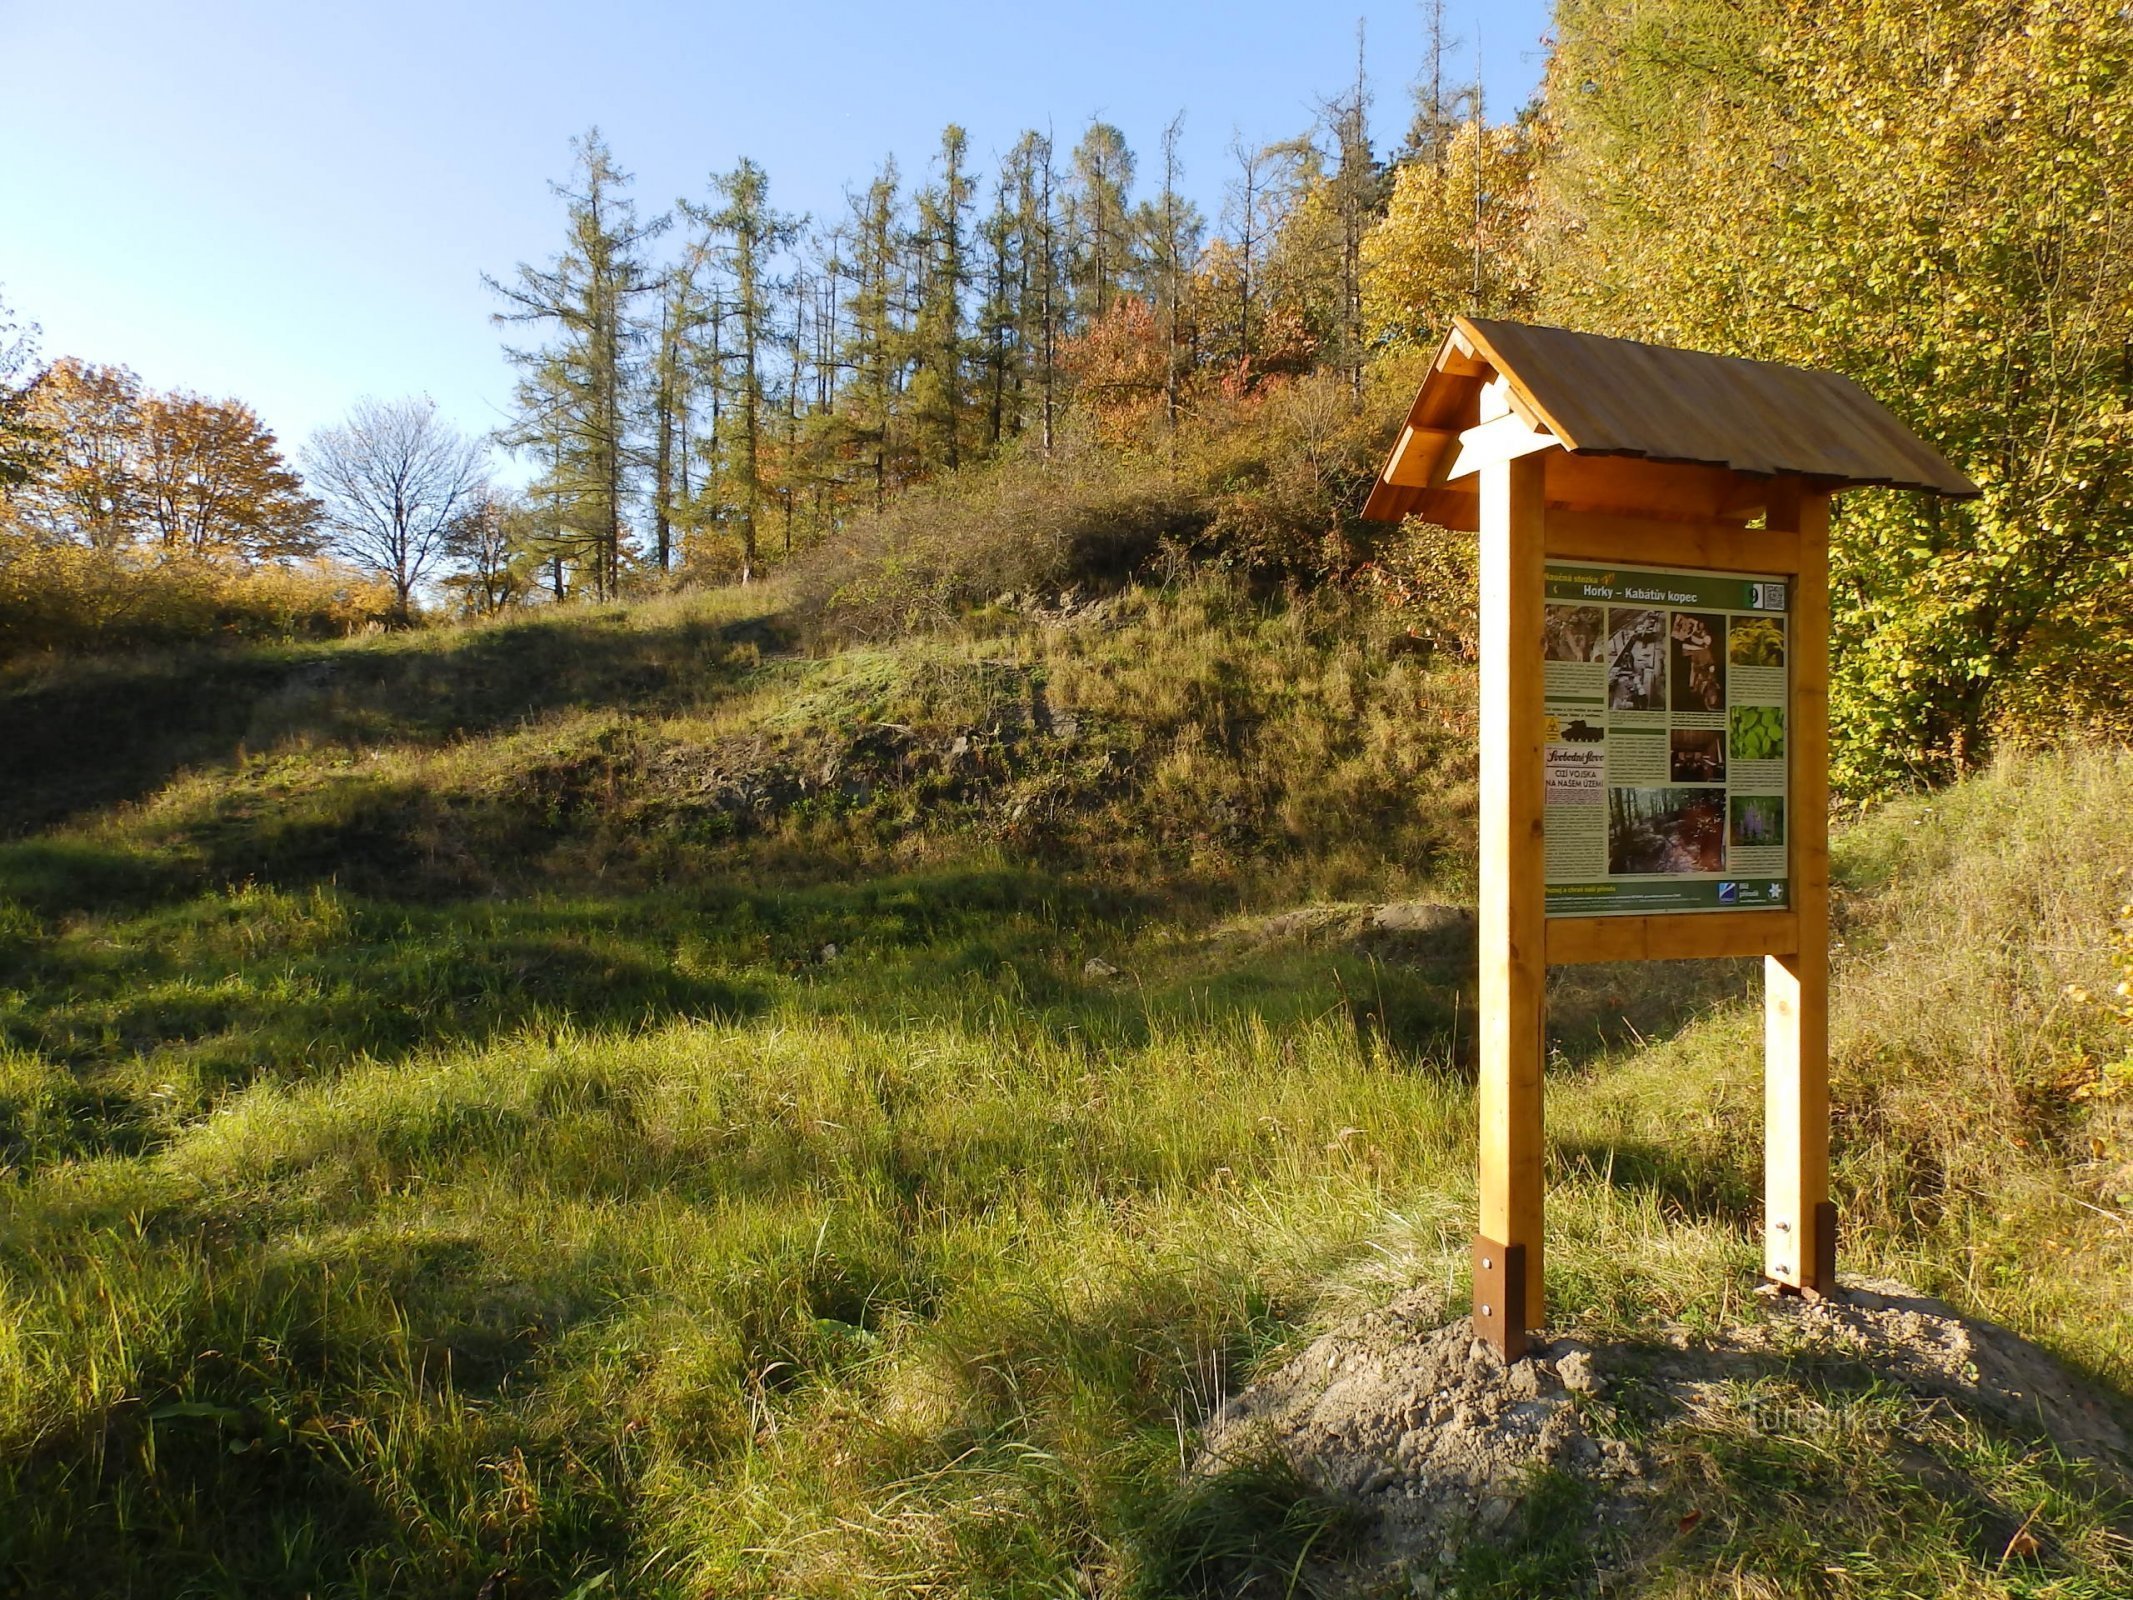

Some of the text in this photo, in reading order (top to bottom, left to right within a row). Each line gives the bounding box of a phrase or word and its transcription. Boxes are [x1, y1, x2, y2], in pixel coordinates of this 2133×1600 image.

[1583, 584, 1613, 599] Horky
[1625, 587, 1666, 601] Kabátův
[1667, 590, 1697, 603] kopec
[1749, 588, 1758, 604] 9
